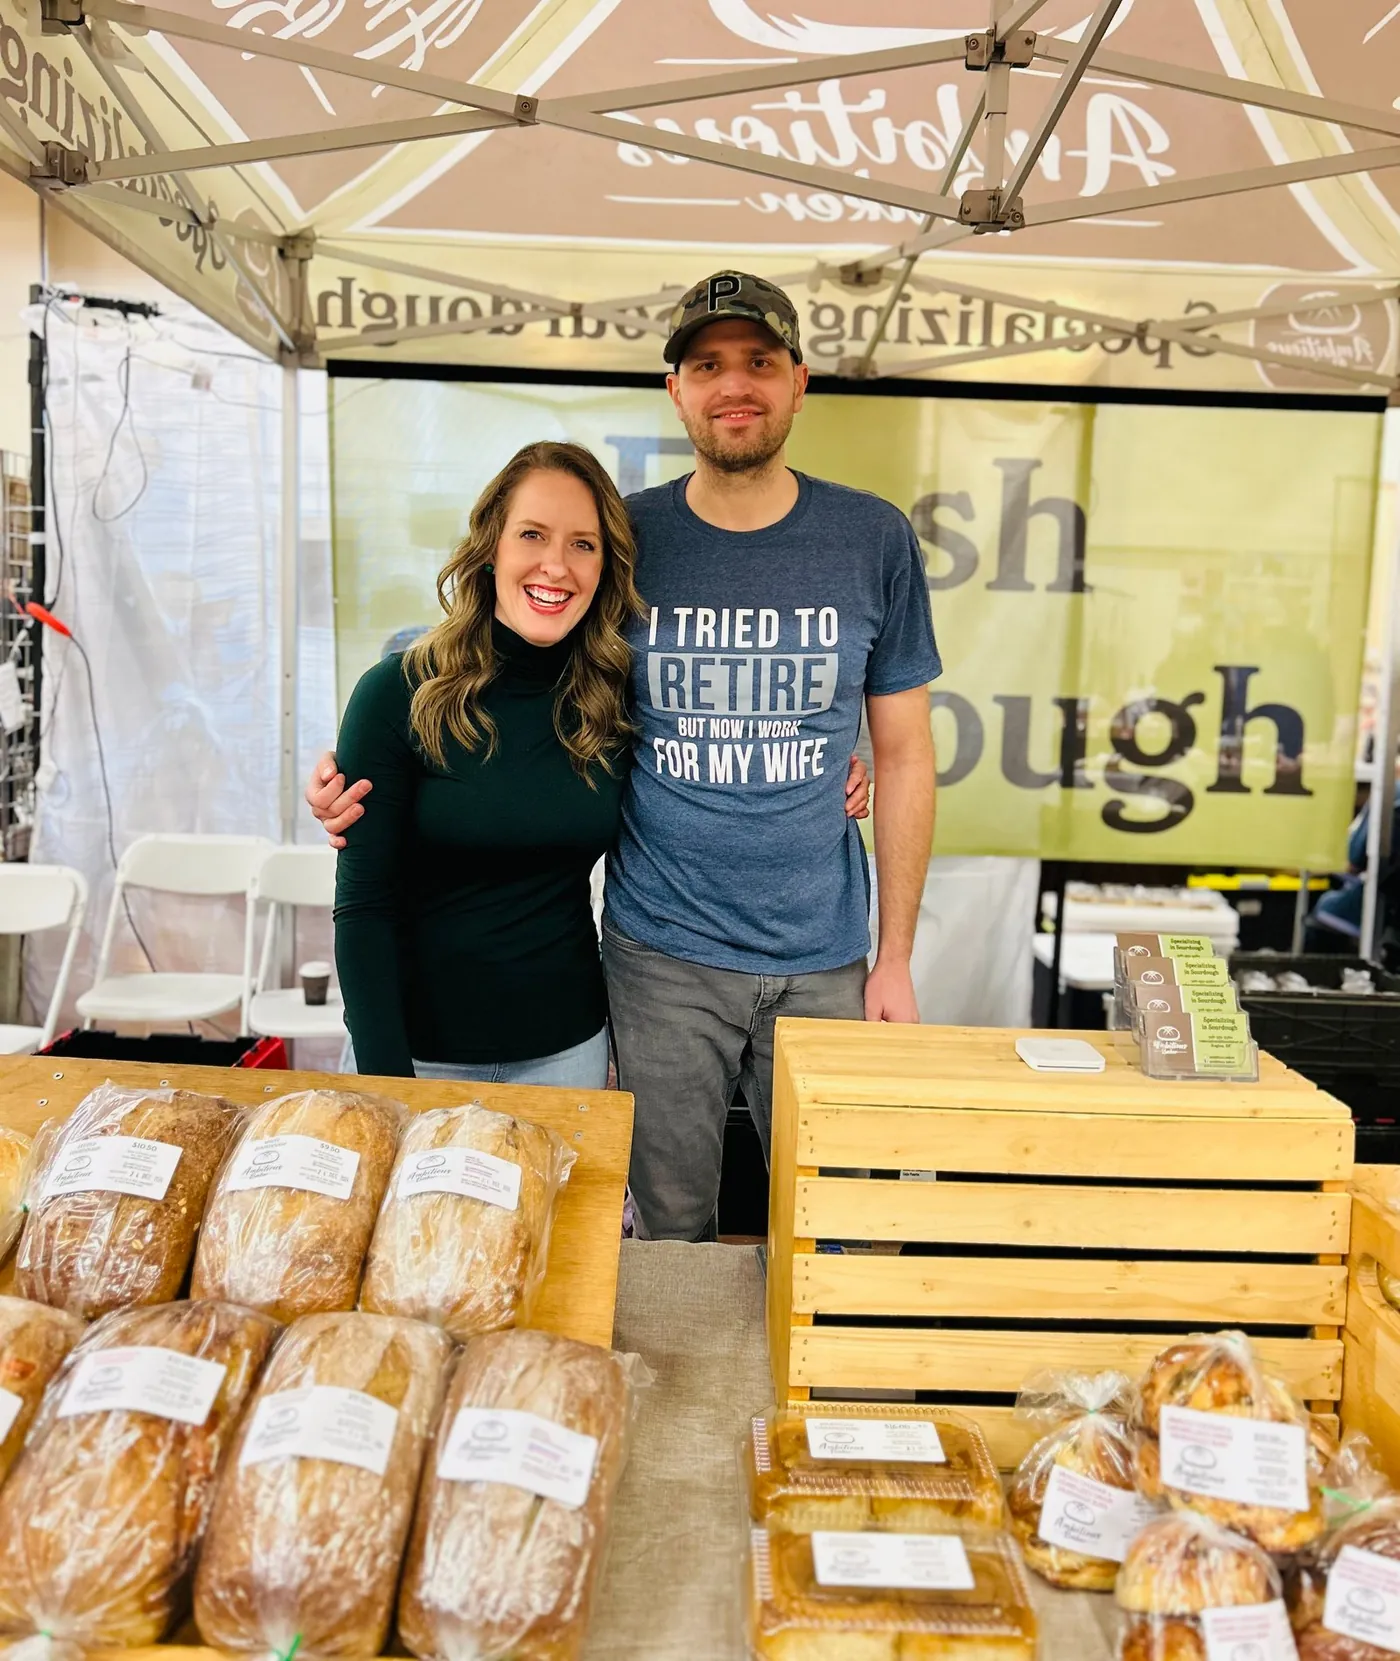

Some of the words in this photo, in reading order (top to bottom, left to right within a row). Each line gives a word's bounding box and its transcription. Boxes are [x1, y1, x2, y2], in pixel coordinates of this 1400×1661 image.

[706, 275, 741, 312] P
[648, 606, 659, 646] I
[673, 606, 780, 648] TRIED
[794, 606, 839, 648] TO
[660, 656, 827, 712] RETIRE
[678, 716, 707, 738] BUT
[710, 718, 744, 739] NOW
[748, 719, 753, 739] I
[758, 719, 802, 738] WORK
[653, 737, 700, 782] FOR
[708, 743, 754, 784] MY
[762, 737, 828, 783] WIFE
[1170, 938, 1201, 946] Specializing
[1185, 962, 1217, 970] Specializing
[1191, 969, 1219, 977] Sourdough
[1192, 990, 1224, 998] Specializing
[1198, 997, 1227, 1005] Sourdough
[1203, 1017, 1236, 1025] Specializing
[1208, 1024, 1238, 1032] Sourdough
